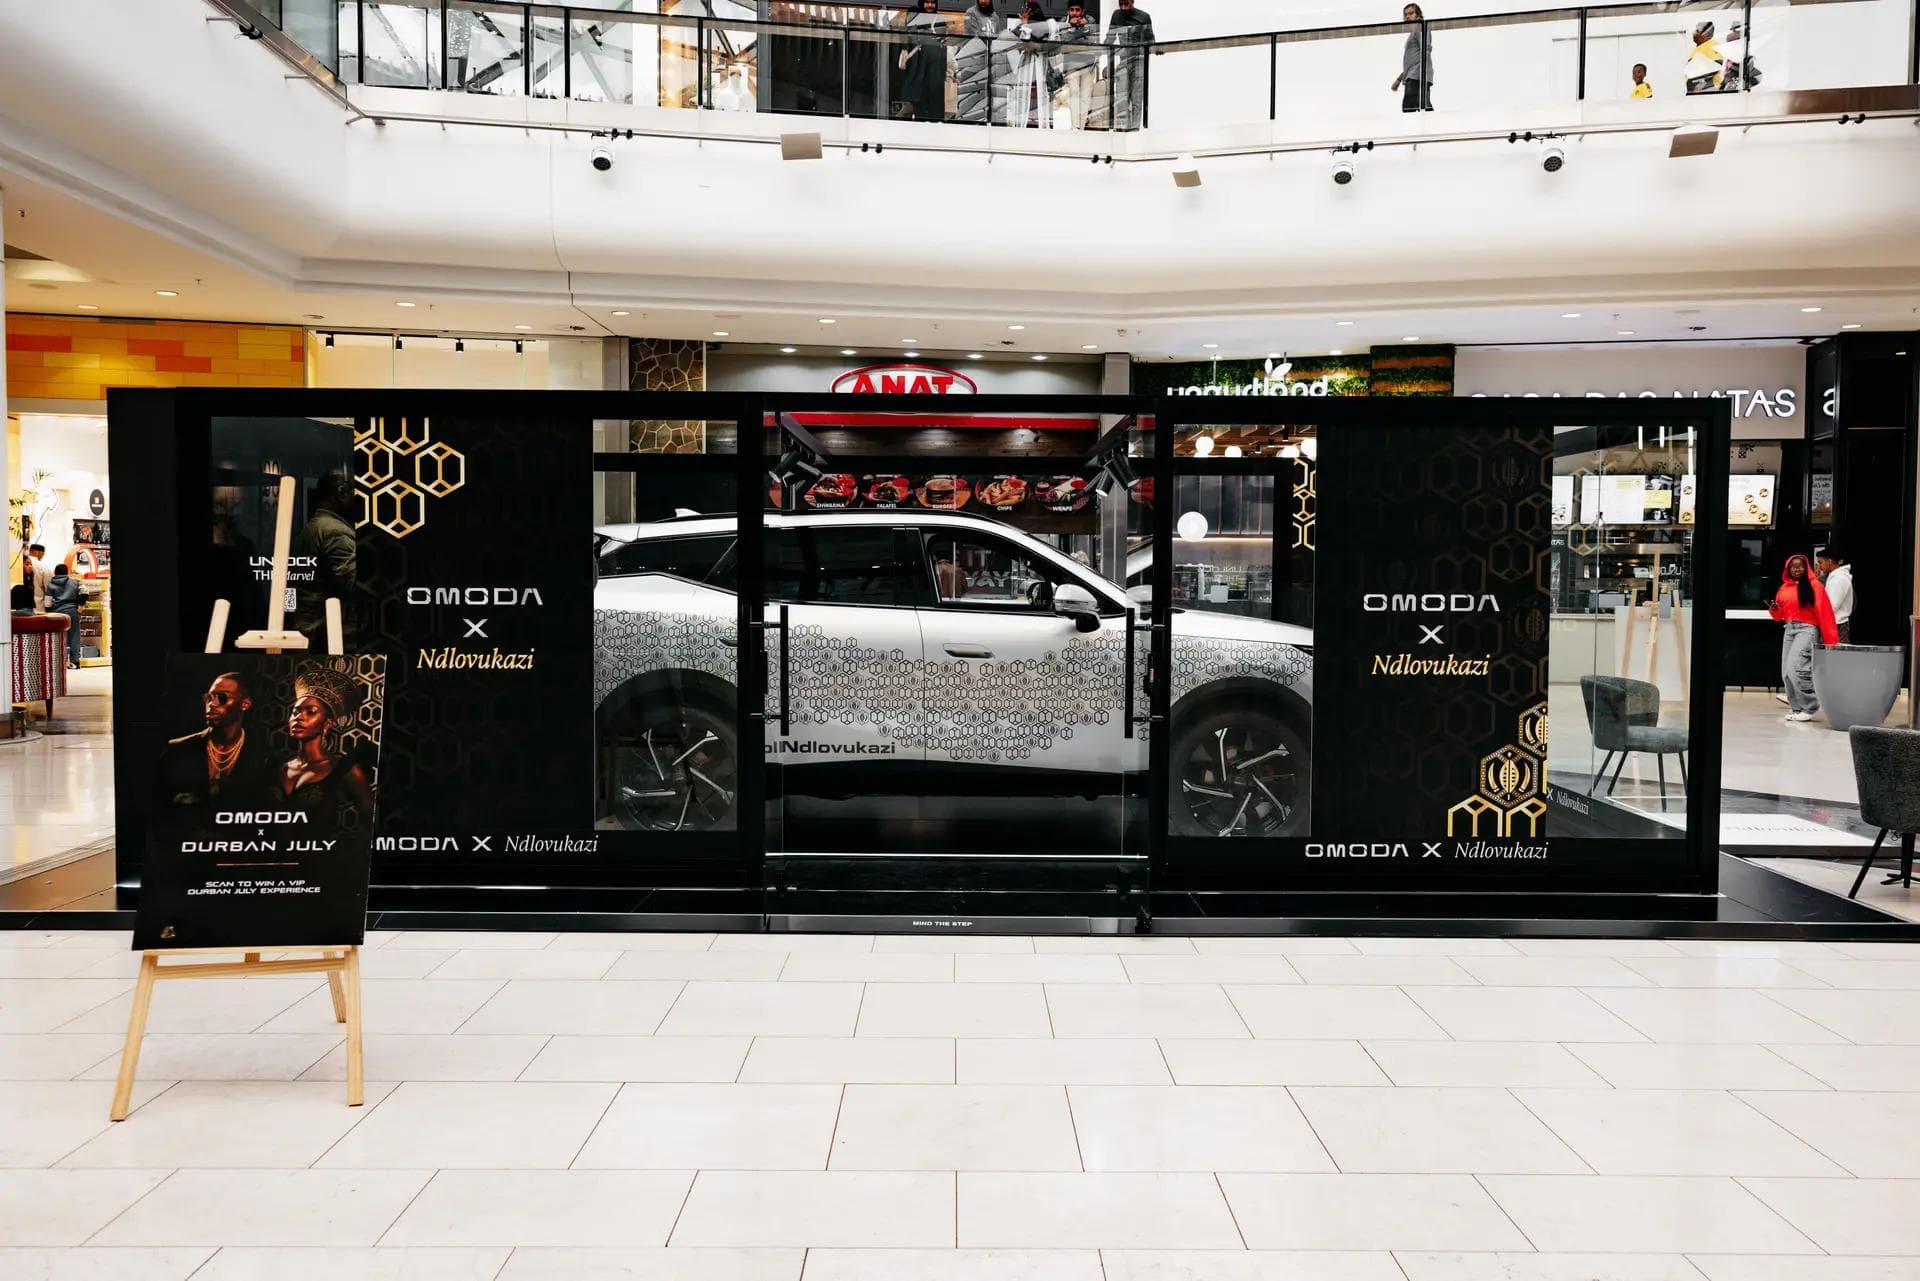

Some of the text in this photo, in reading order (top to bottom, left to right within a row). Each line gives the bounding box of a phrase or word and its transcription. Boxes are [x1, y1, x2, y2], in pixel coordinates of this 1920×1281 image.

[852, 373, 953, 394] ANAT
[1673, 389, 1796, 418] TAS
[250, 556, 318, 567] UNOCK
[253, 569, 273, 581] TH
[407, 587, 543, 606] OMODA
[1363, 594, 1500, 612] OMODA
[462, 618, 489, 638] X
[1418, 624, 1445, 645] X
[416, 647, 535, 670] Ndlovukazi
[1371, 653, 1491, 675] Ndlovukazi
[215, 811, 309, 824] OMODA
[181, 840, 337, 853] DURBAN JULY
[371, 835, 599, 852] MODA X Ndlovukazi
[1305, 842, 1550, 860] OMODA X Ndlovukazi
[260, 886, 321, 894] EXPERIENCE
